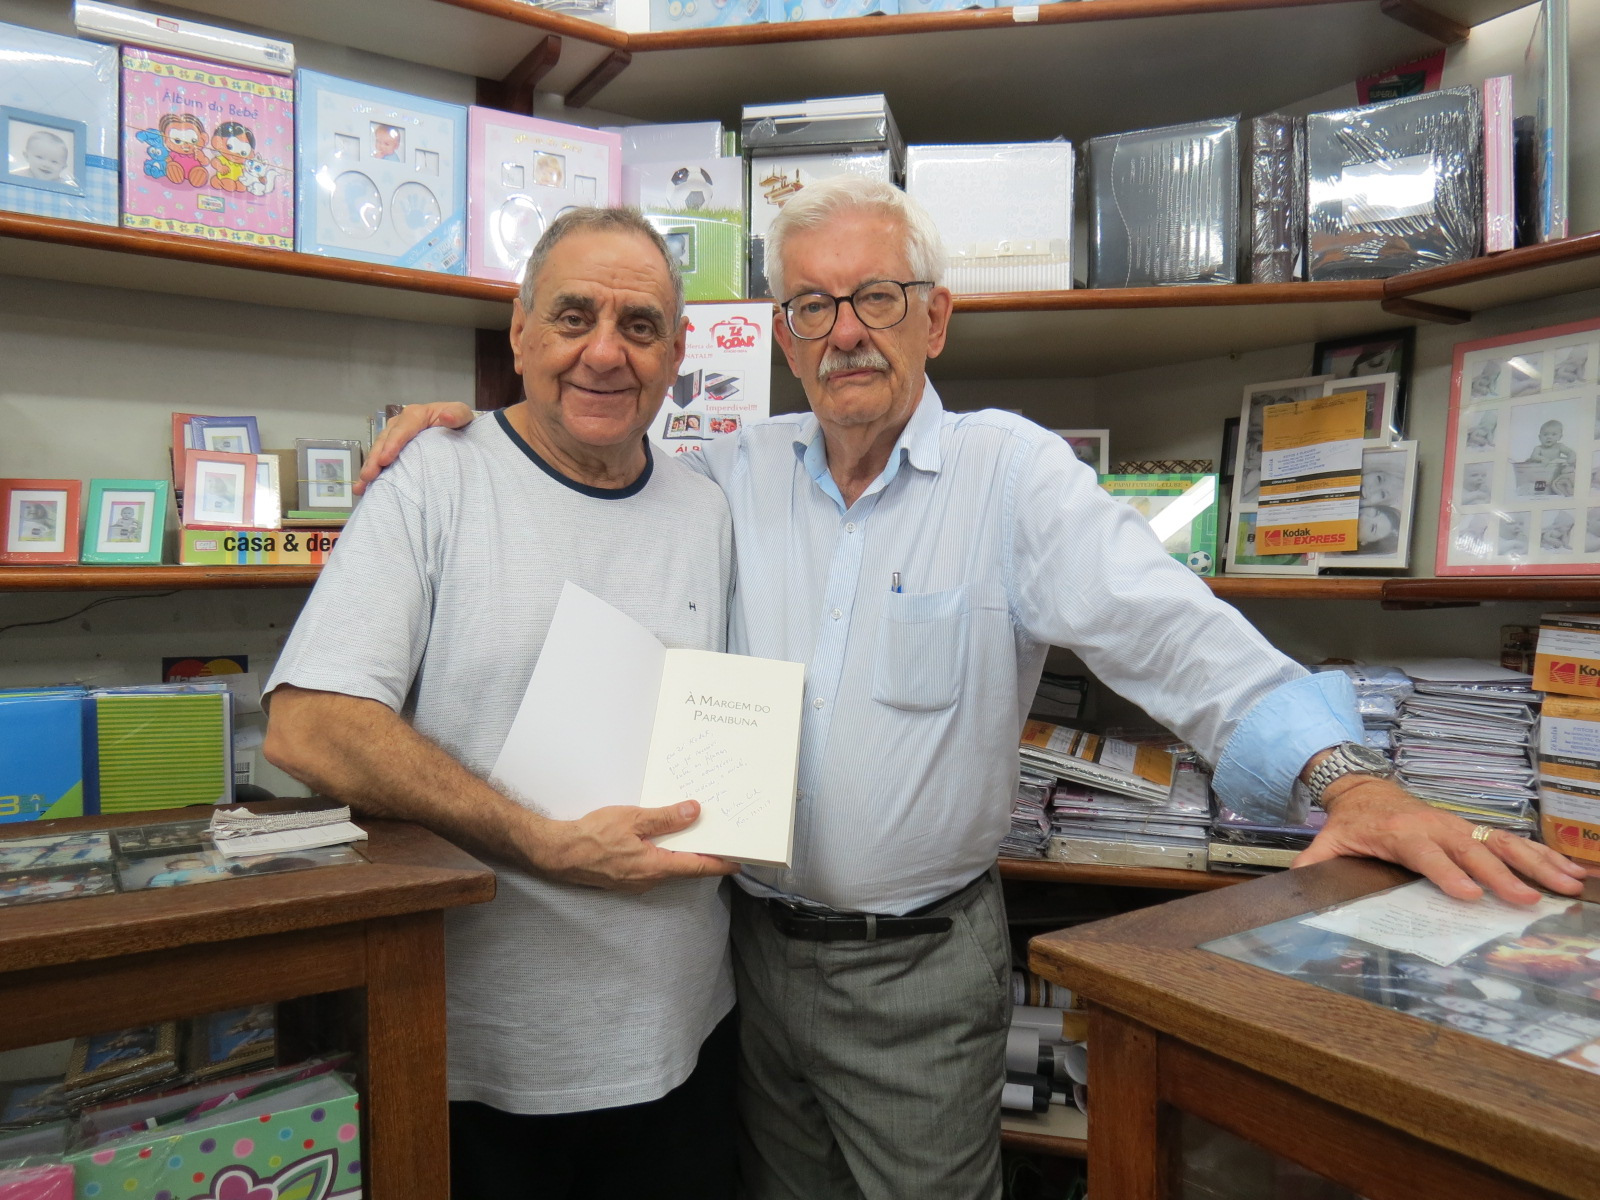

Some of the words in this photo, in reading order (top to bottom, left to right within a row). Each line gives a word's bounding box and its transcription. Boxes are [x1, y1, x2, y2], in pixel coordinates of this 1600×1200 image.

[162, 89, 203, 108] Álbum
[208, 101, 224, 112] do
[229, 103, 259, 120] Bebê
[1283, 528, 1311, 538] Kodak
[1294, 533, 1346, 546] EXPRESS
[224, 536, 276, 552] casa
[283, 533, 299, 552] &
[688, 600, 697, 612] H
[685, 691, 696, 705] À
